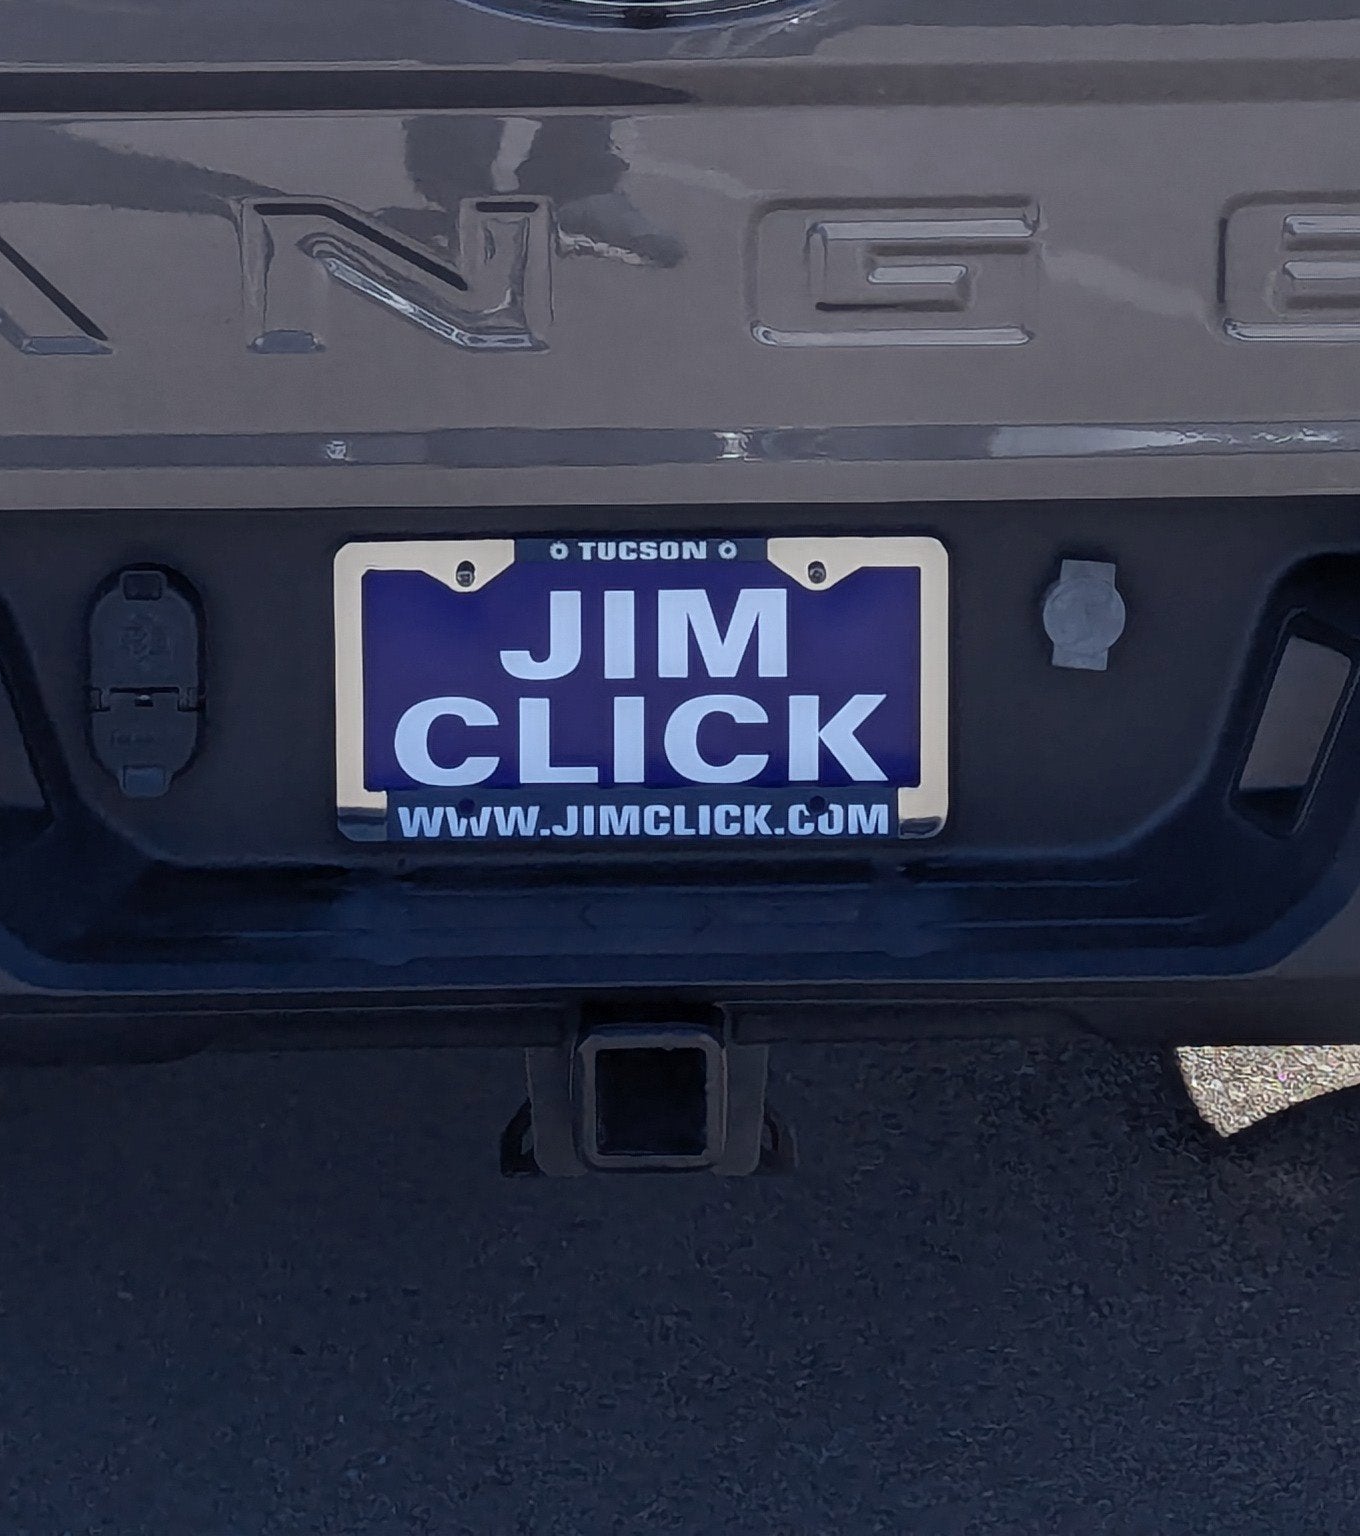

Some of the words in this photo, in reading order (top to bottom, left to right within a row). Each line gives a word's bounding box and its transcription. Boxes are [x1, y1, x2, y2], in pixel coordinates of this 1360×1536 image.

[578, 541, 708, 561] TUCSON
[499, 588, 788, 681] JIM
[393, 694, 890, 787] CLICK
[397, 804, 890, 839] WWW.JIMCLICK.COM
